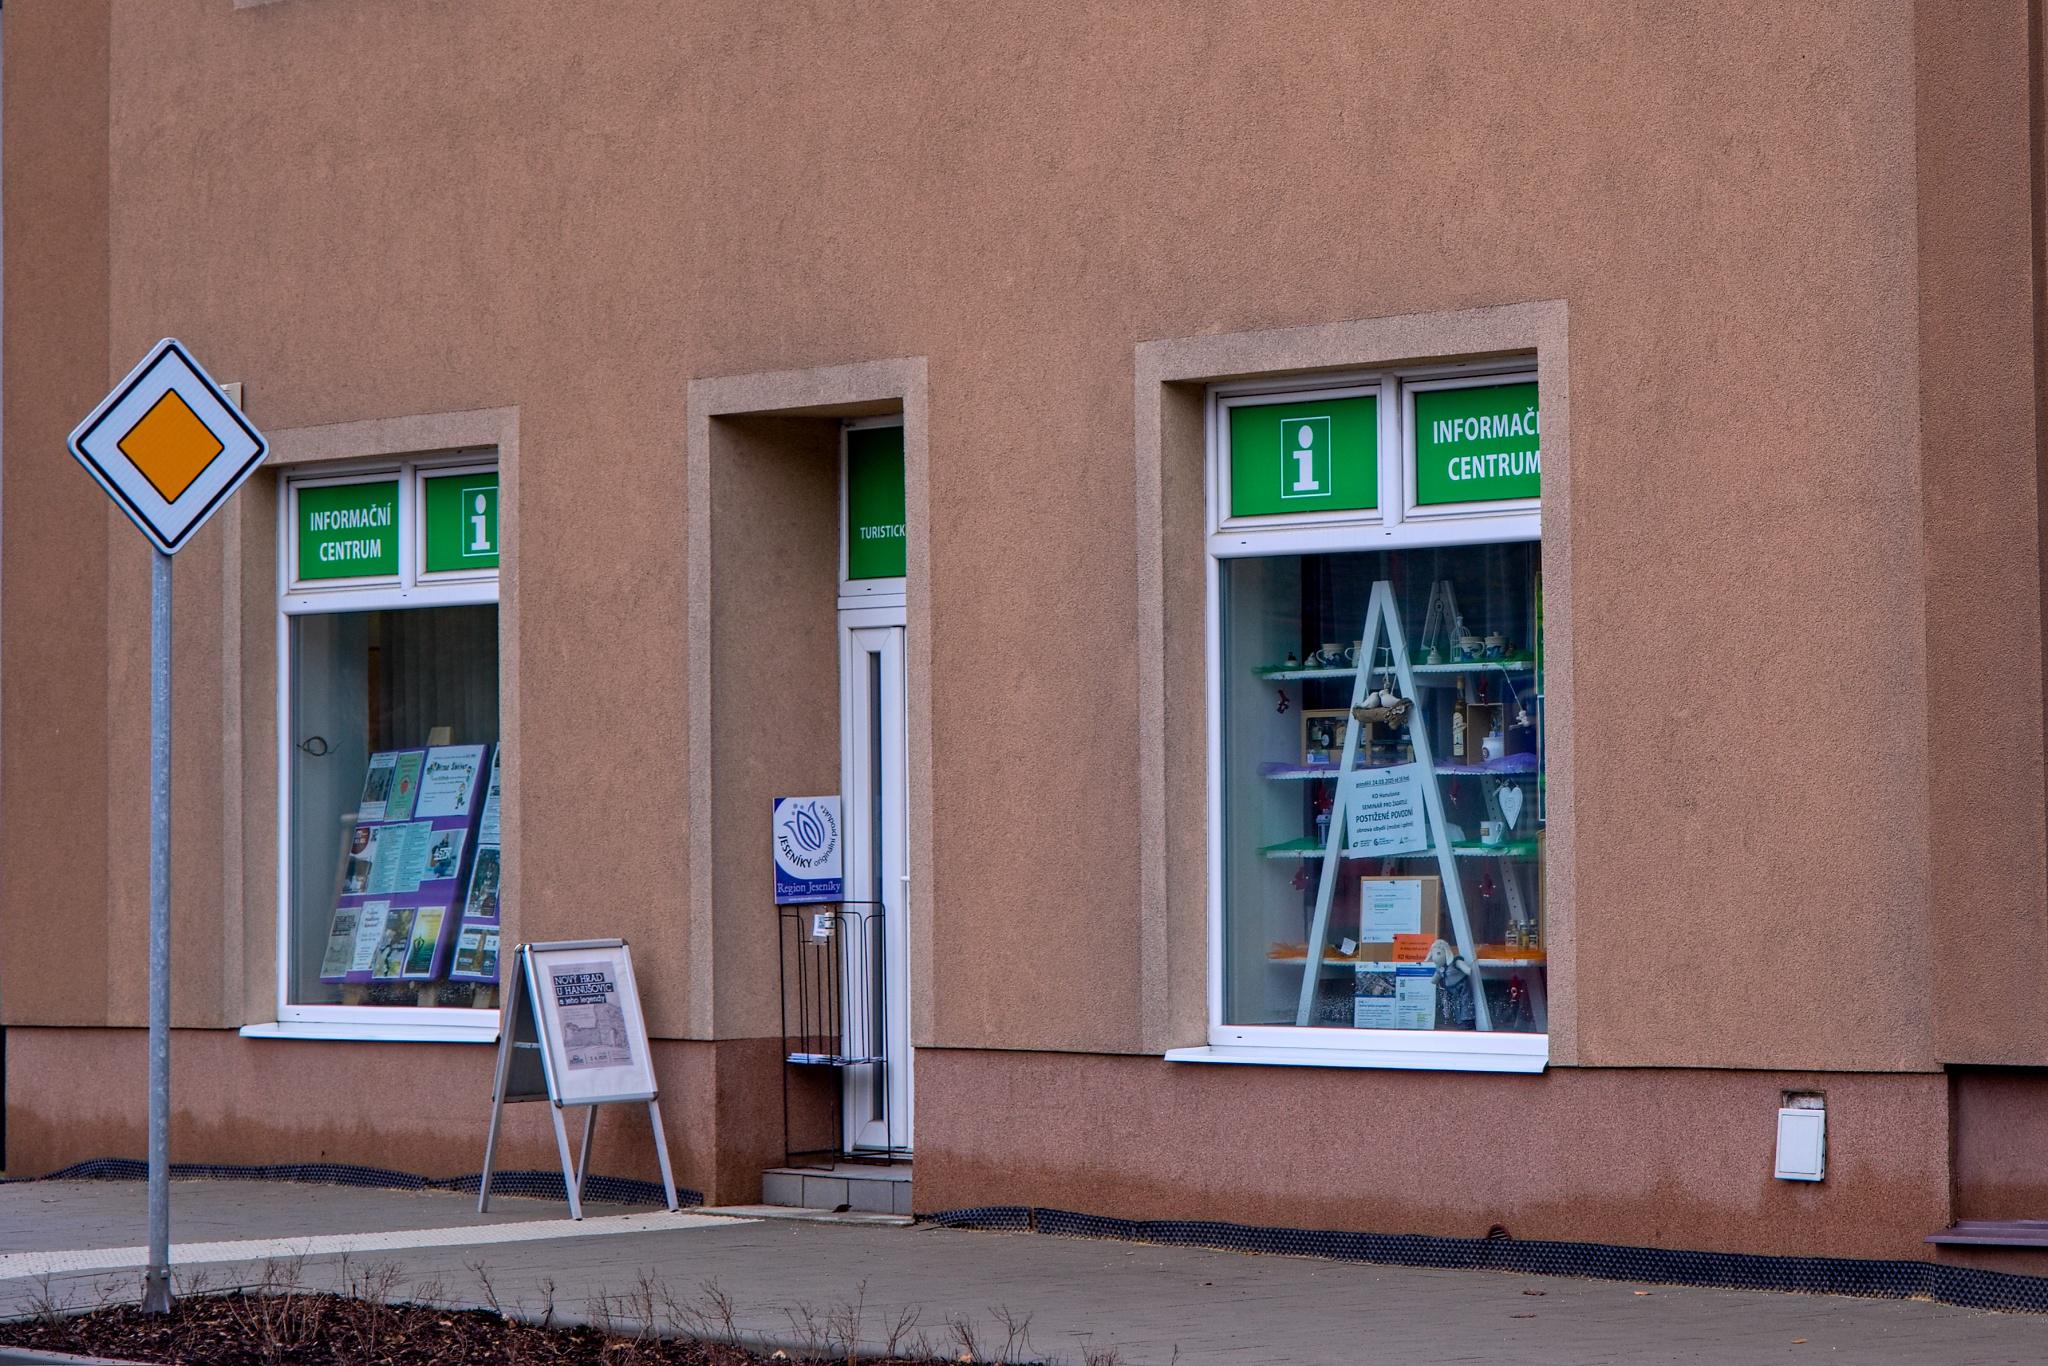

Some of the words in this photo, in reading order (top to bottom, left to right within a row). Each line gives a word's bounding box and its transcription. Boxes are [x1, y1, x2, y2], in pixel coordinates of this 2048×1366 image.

[1433, 406, 1540, 443] INFORMAČ
[1448, 452, 1541, 481] CENTRUM
[310, 502, 391, 531] INFORMAČNÍ
[319, 539, 381, 561] CENTRUM
[1356, 811, 1390, 823] POSTIŽENÉ
[778, 835, 812, 868] JESENÍKY
[813, 838, 836, 867] originální
[777, 882, 806, 895] Region
[806, 881, 841, 894] Jeseníky
[555, 974, 577, 985] NOVÝ
[580, 973, 603, 983] HRAD
[556, 987, 562, 996] U
[564, 984, 612, 995] HANUŠOVIC
